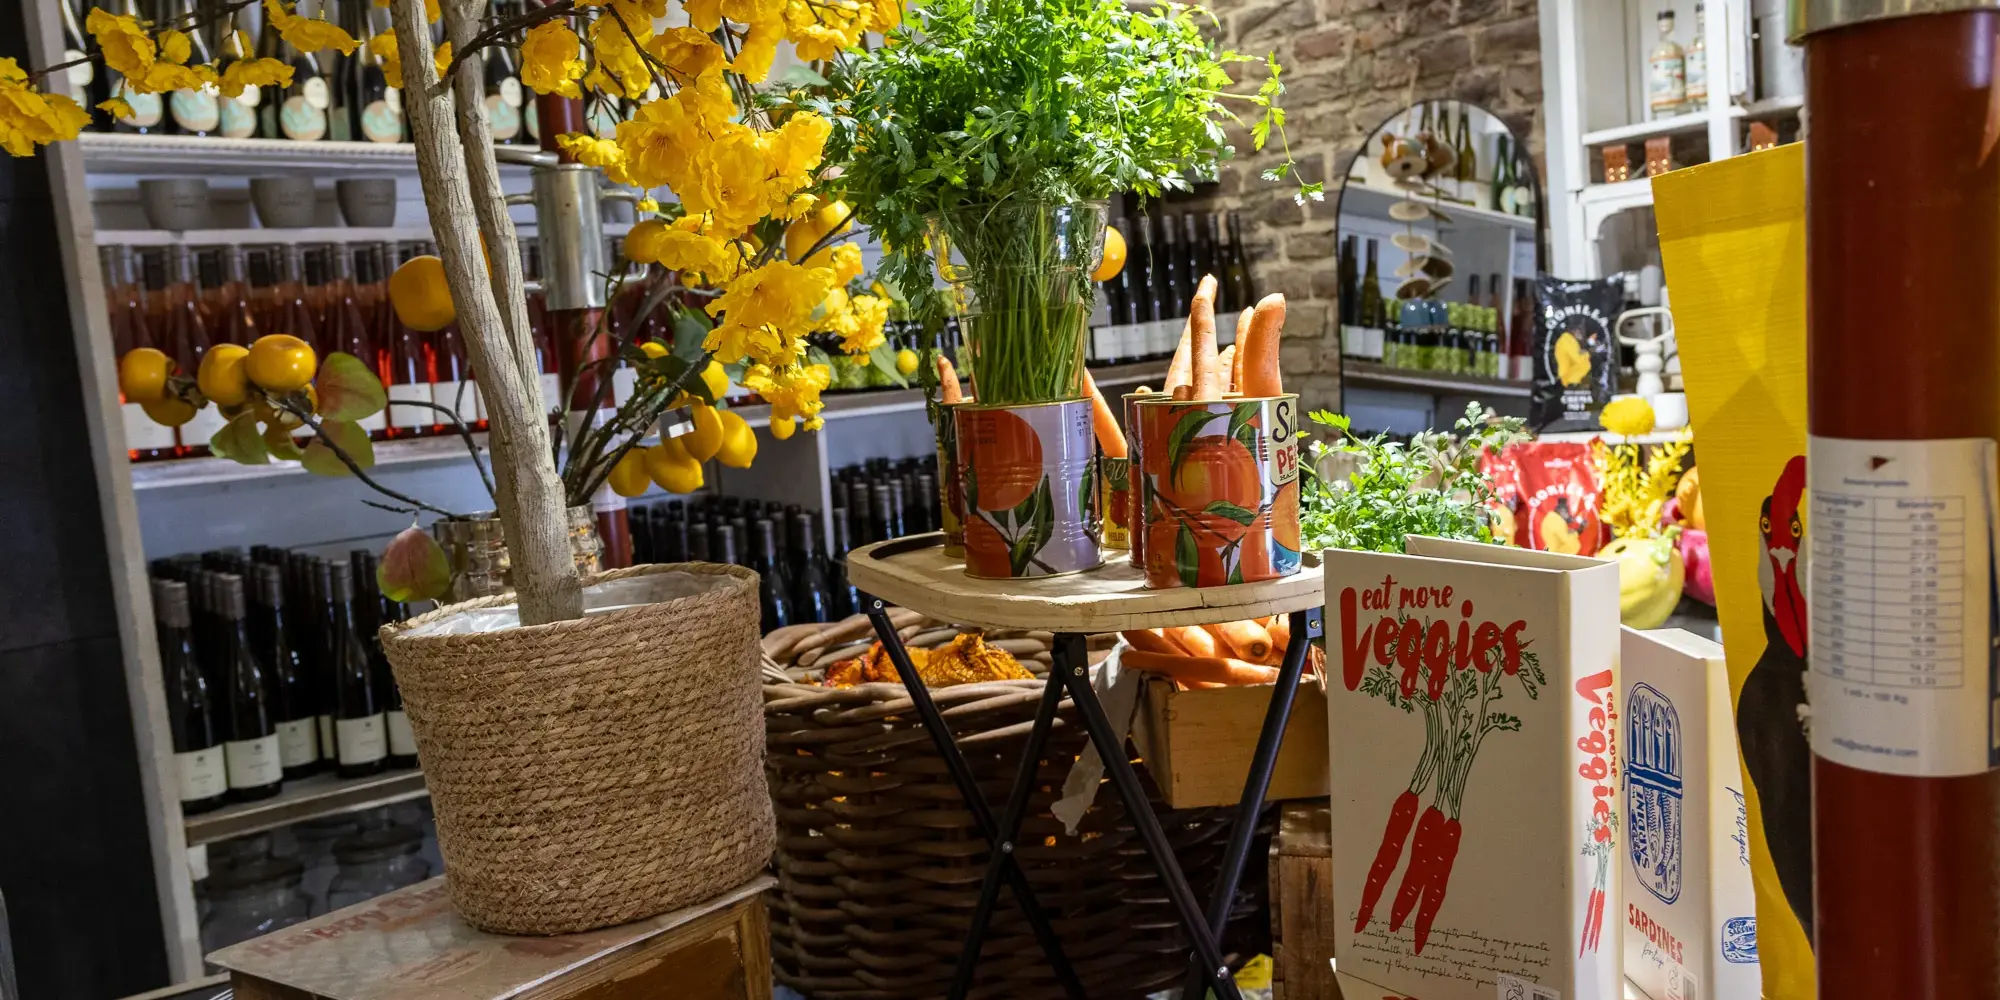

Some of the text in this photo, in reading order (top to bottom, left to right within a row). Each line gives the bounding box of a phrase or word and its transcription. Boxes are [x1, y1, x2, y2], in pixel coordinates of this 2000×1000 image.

[1361, 574, 1454, 610] eat more
[1340, 586, 1535, 700] Veggies
[1607, 691, 1618, 778] eat more
[1575, 669, 1615, 843] Veggies
[1492, 938, 1510, 951] may
[1512, 941, 1550, 952] promote
[1628, 903, 1683, 965] SARDINES
[1353, 939, 1375, 949] brain
[1450, 959, 1478, 971] regret
[1384, 959, 1393, 974] of
[1395, 959, 1412, 971] this
[1414, 966, 1452, 978] vegetable
[1455, 971, 1473, 981] into
[1503, 952, 1520, 961] and
[1523, 954, 1550, 967] boost
